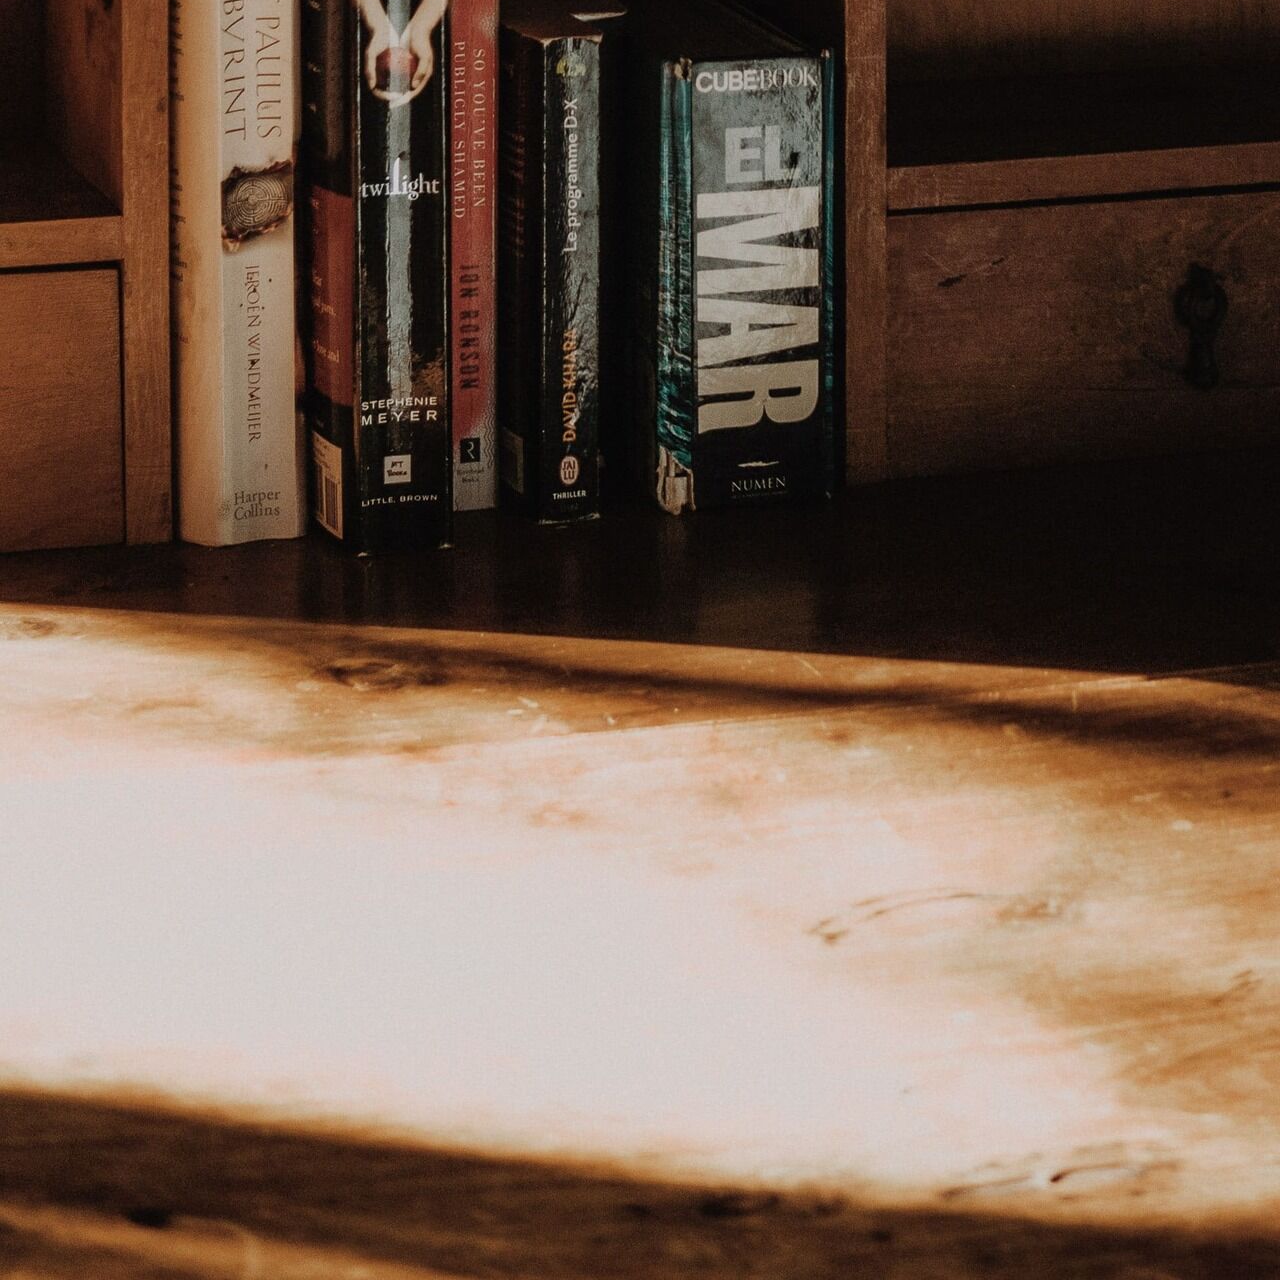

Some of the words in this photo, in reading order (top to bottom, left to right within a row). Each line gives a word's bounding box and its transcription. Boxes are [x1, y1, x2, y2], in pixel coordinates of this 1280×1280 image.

[255, 16, 283, 139] PAULUS
[472, 48, 486, 72] SO
[454, 41, 466, 131] PUBLICLY
[472, 80, 486, 150] YOU'VE
[563, 97, 578, 128] D-X
[361, 156, 440, 201] twilight
[725, 124, 799, 184] EL
[454, 140, 466, 219] SHAMED
[472, 159, 486, 208] BEEN
[567, 133, 582, 228] programme
[563, 230, 578, 252] Le
[244, 265, 261, 328] JEROEN
[696, 186, 820, 434] MAR
[459, 309, 480, 389] RONSON
[562, 327, 578, 389] KHARA
[247, 333, 262, 442] WINDMEIJER
[361, 396, 438, 411] STEPHENIE
[361, 410, 438, 426] MEYER
[562, 390, 578, 443] DAVID
[233, 490, 281, 507] Harper
[400, 494, 438, 503] BROWN
[552, 490, 587, 501] THRILLER
[563, 470, 575, 480] LU
[731, 476, 787, 492] NUMEN
[233, 503, 281, 521] Collins
